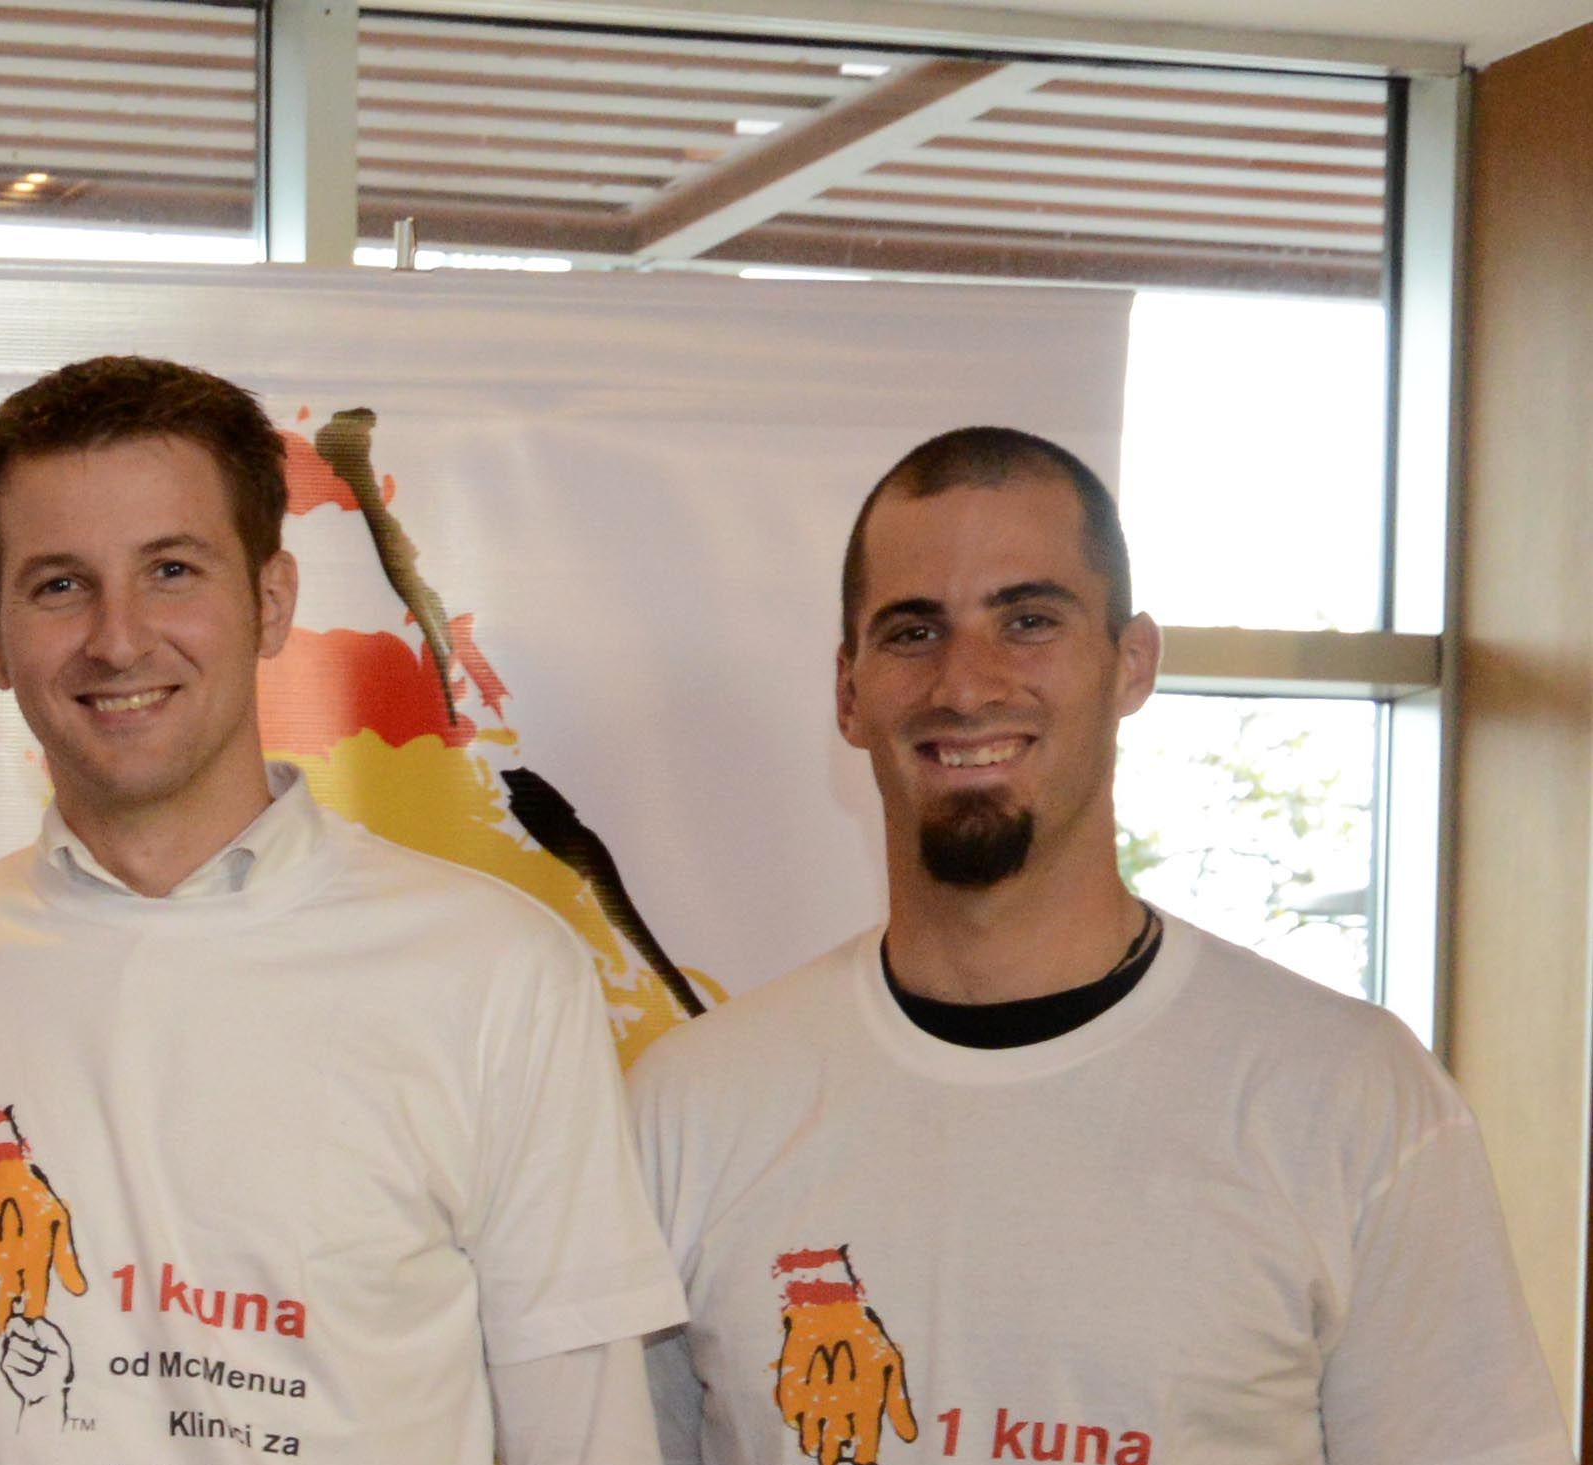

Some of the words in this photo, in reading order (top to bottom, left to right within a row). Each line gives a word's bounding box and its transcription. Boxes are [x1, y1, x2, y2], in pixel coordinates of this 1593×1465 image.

[111, 1263, 135, 1313] 1
[158, 1262, 306, 1339] kuna
[109, 1351, 149, 1376] od
[159, 1352, 307, 1399] McMenua
[262, 1433, 300, 1456] za
[936, 1407, 962, 1457] 1
